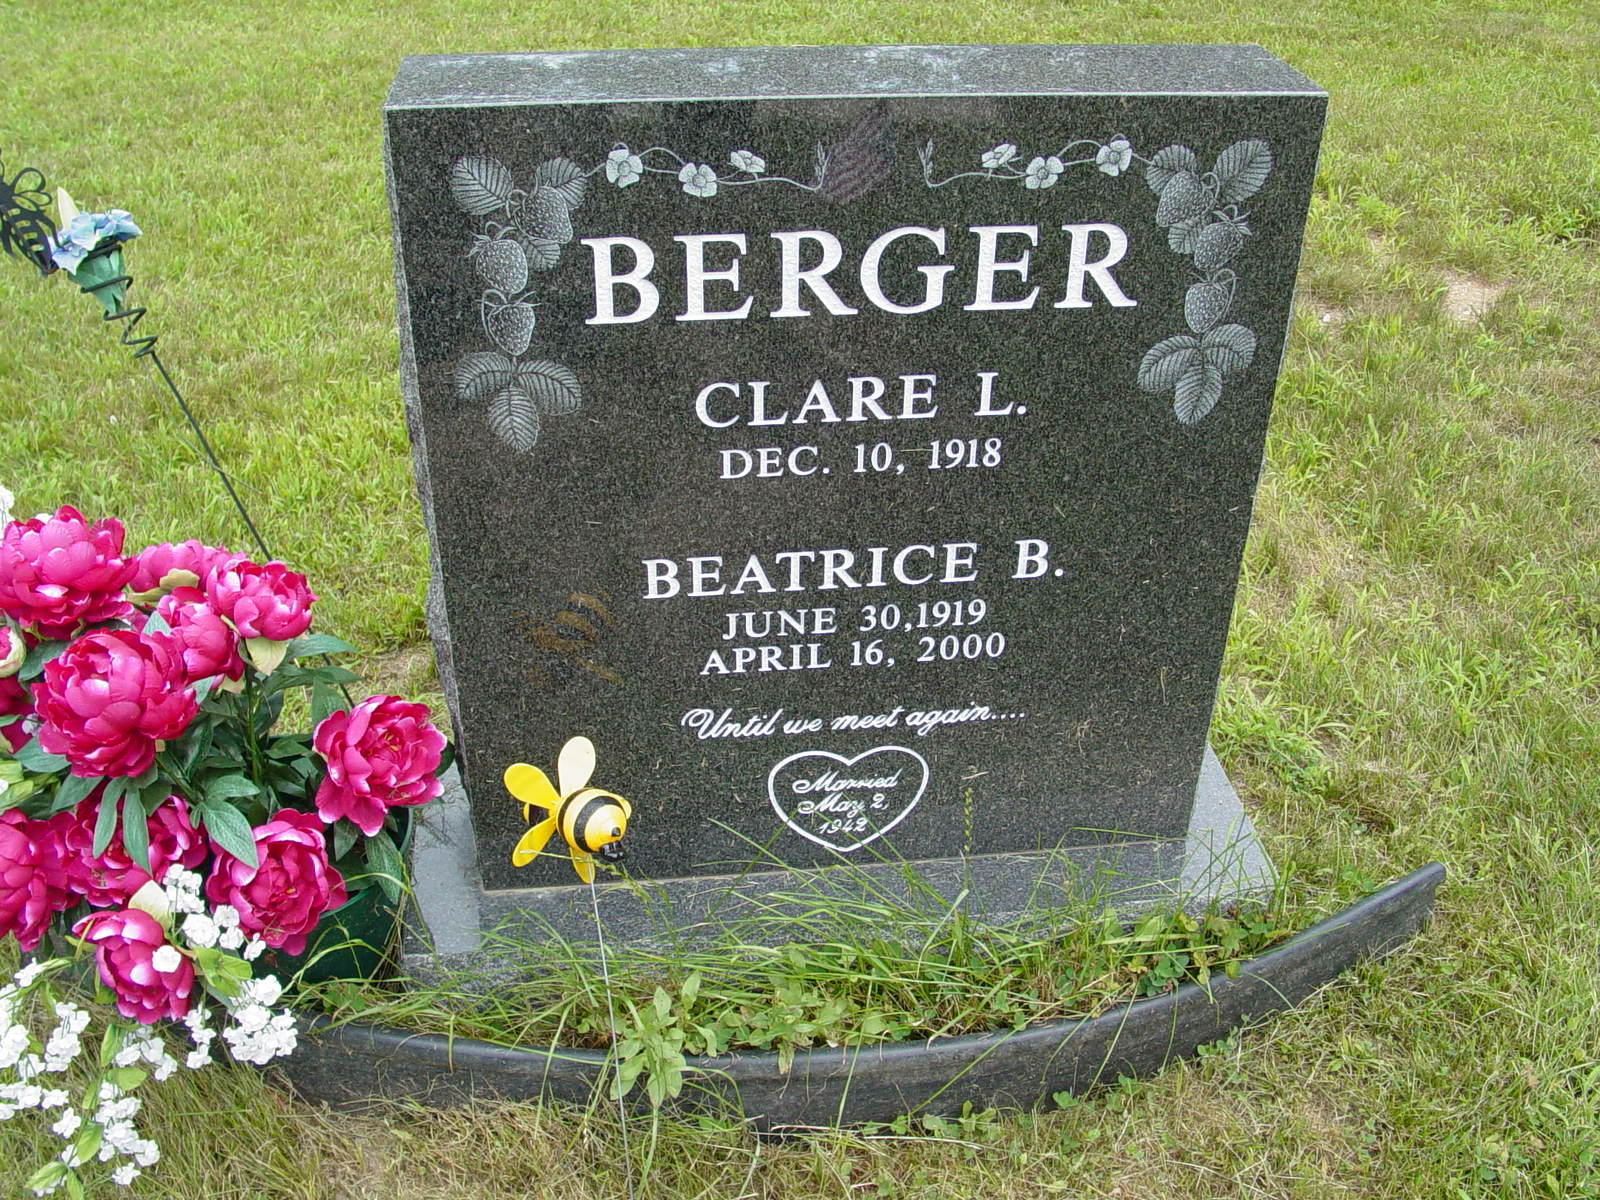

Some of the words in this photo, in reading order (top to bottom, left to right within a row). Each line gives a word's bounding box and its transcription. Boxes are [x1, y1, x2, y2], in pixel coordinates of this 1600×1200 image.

[580, 223, 1137, 326] BERGER
[695, 373, 938, 429] CLARE
[975, 371, 1027, 419] L.
[719, 444, 830, 482] DEC.
[855, 441, 905, 477] 10,
[930, 437, 1003, 470] 1918
[642, 542, 978, 600] BEATRICE
[1011, 538, 1065, 580] B.
[722, 607, 837, 641] JUNE
[700, 643, 832, 676] APRIL
[851, 640, 896, 669] 16,
[916, 632, 1006, 663] 2000
[681, 707, 783, 740] Until
[783, 716, 823, 734] we
[831, 705, 899, 731] meet
[792, 768, 903, 794] Married
[797, 791, 864, 819] May
